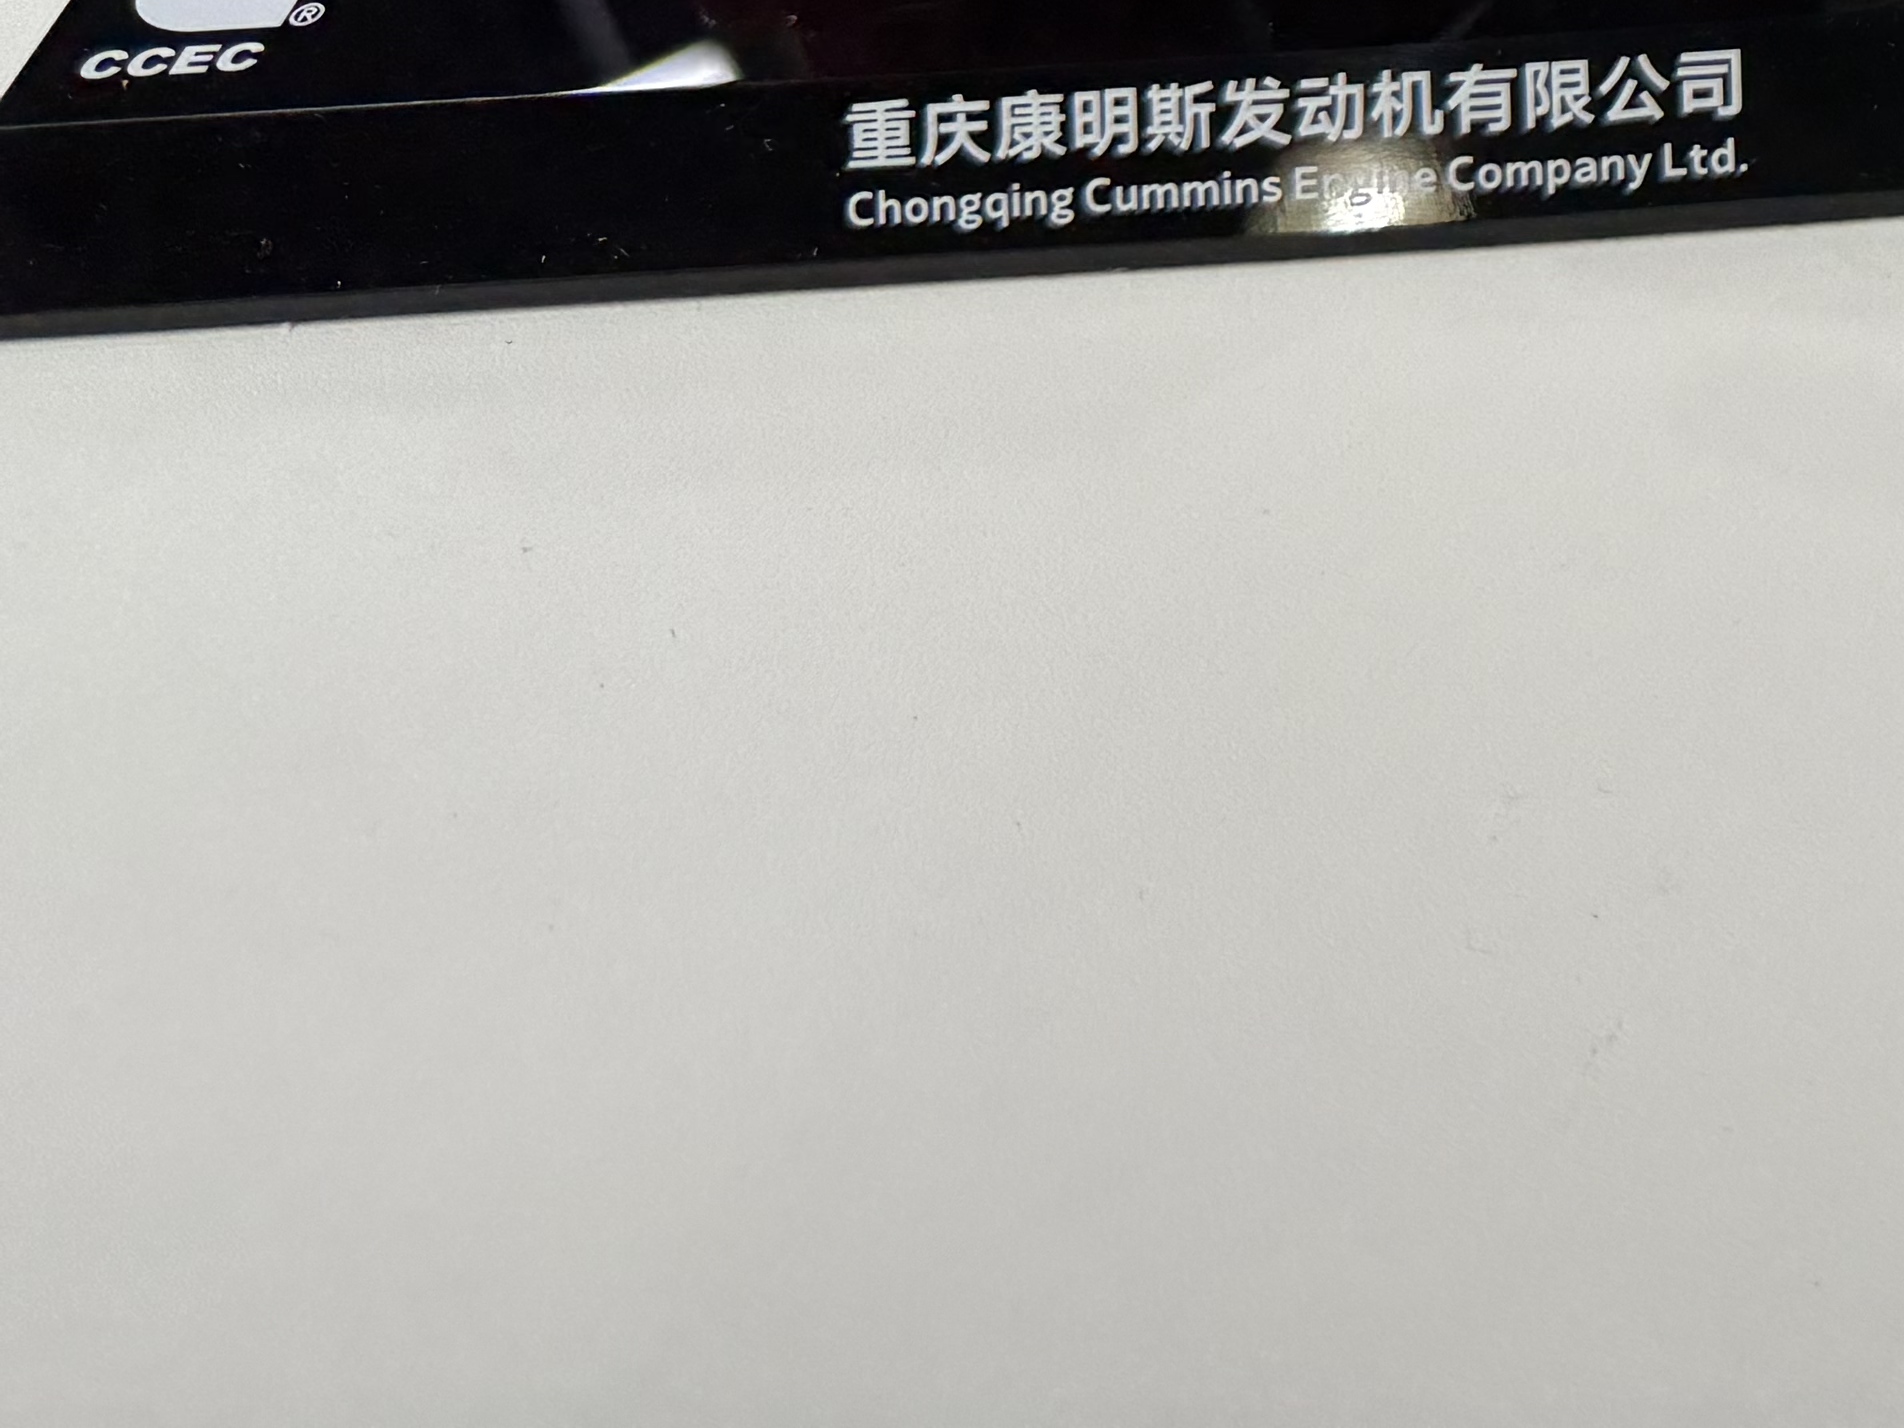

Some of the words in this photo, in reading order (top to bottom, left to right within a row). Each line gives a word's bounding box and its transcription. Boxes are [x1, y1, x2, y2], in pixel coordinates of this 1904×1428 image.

[79, 41, 265, 80] CCEC
[843, 48, 1744, 170] 重庆康明斯发动机有限公司
[845, 182, 1075, 231] Chongqing
[1083, 170, 1283, 215] Cummins
[1446, 151, 1653, 198] Company
[1660, 137, 1749, 183] Ltd.
